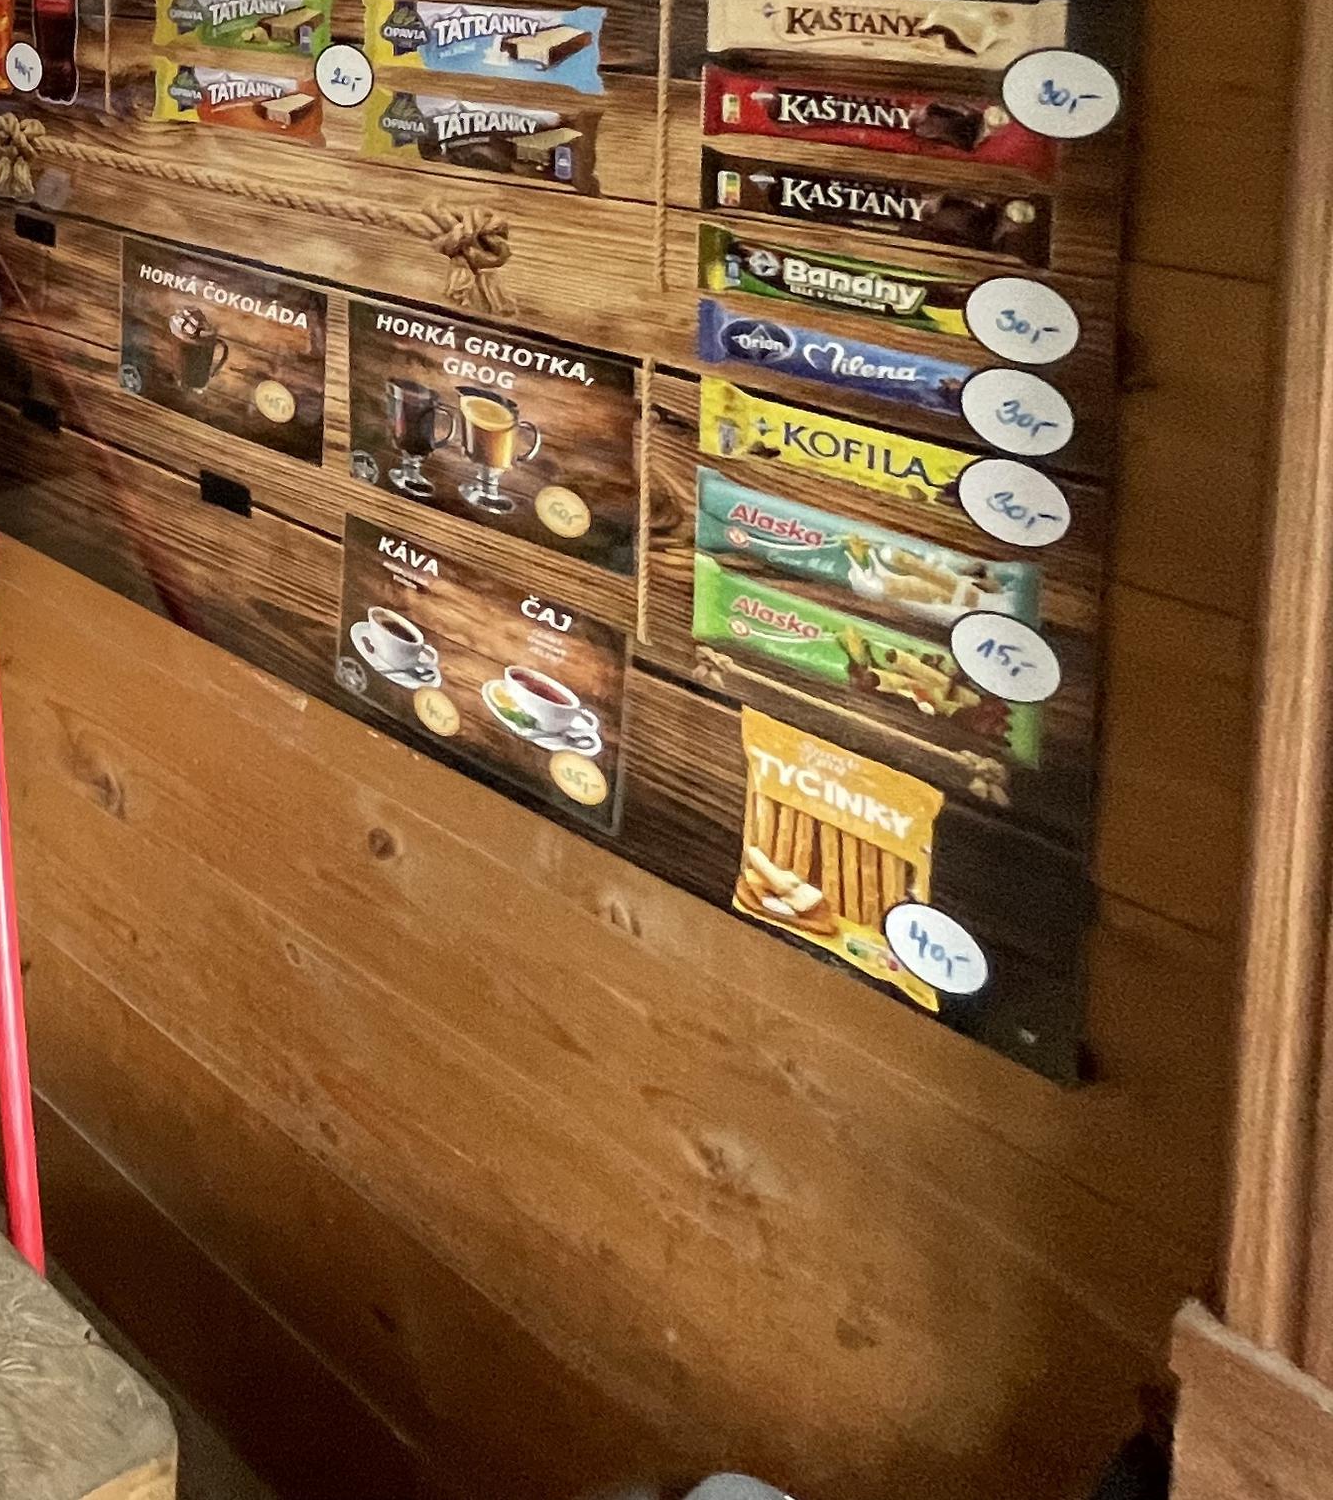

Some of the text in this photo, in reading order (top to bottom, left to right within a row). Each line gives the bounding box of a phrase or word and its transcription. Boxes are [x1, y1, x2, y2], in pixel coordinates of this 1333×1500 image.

[433, 13, 540, 47] TATRANKY
[785, 6, 923, 38] KAŠTANY
[207, 81, 283, 104] TATRANKY
[779, 93, 914, 130] KAŠTANY
[433, 112, 539, 141] TATRANKY
[780, 176, 928, 223] KAŠTANY
[138, 263, 309, 330] HORKÁ ČOKOLÁDA
[783, 258, 927, 314] Banány
[376, 312, 596, 387] HORKÁ GRIOTKA,
[734, 336, 786, 351] Orion
[802, 342, 921, 382] Milena
[442, 358, 517, 390] GROG
[783, 421, 934, 488] KOFILA
[730, 503, 824, 548] Alaska
[378, 535, 440, 577] KÁVA
[520, 594, 573, 633] ČAJ
[733, 596, 822, 639] Alaska
